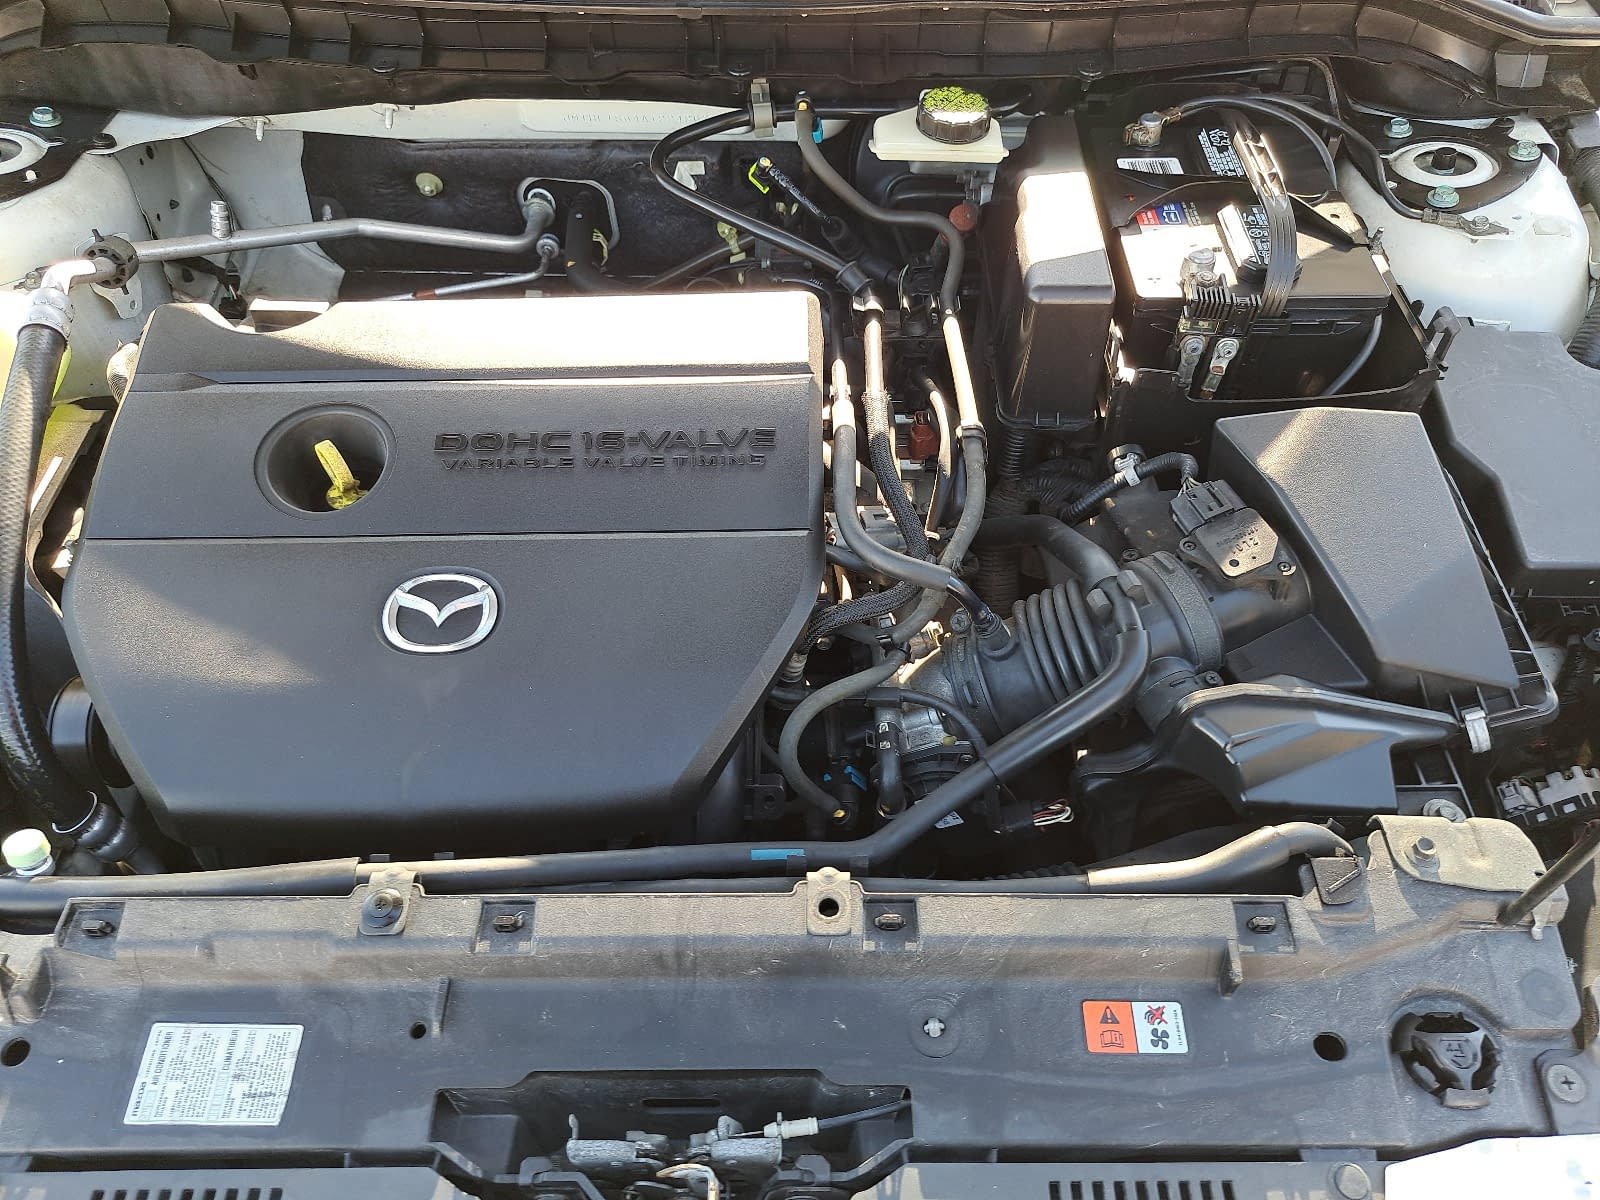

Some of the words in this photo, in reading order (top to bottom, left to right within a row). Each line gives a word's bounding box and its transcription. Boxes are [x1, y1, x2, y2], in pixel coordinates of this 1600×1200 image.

[434, 431, 572, 451] DOHC
[582, 427, 777, 450] 16-VALVE
[441, 456, 575, 470] VARIABLE
[583, 455, 666, 468] VALVE
[672, 453, 768, 467] TIMING
